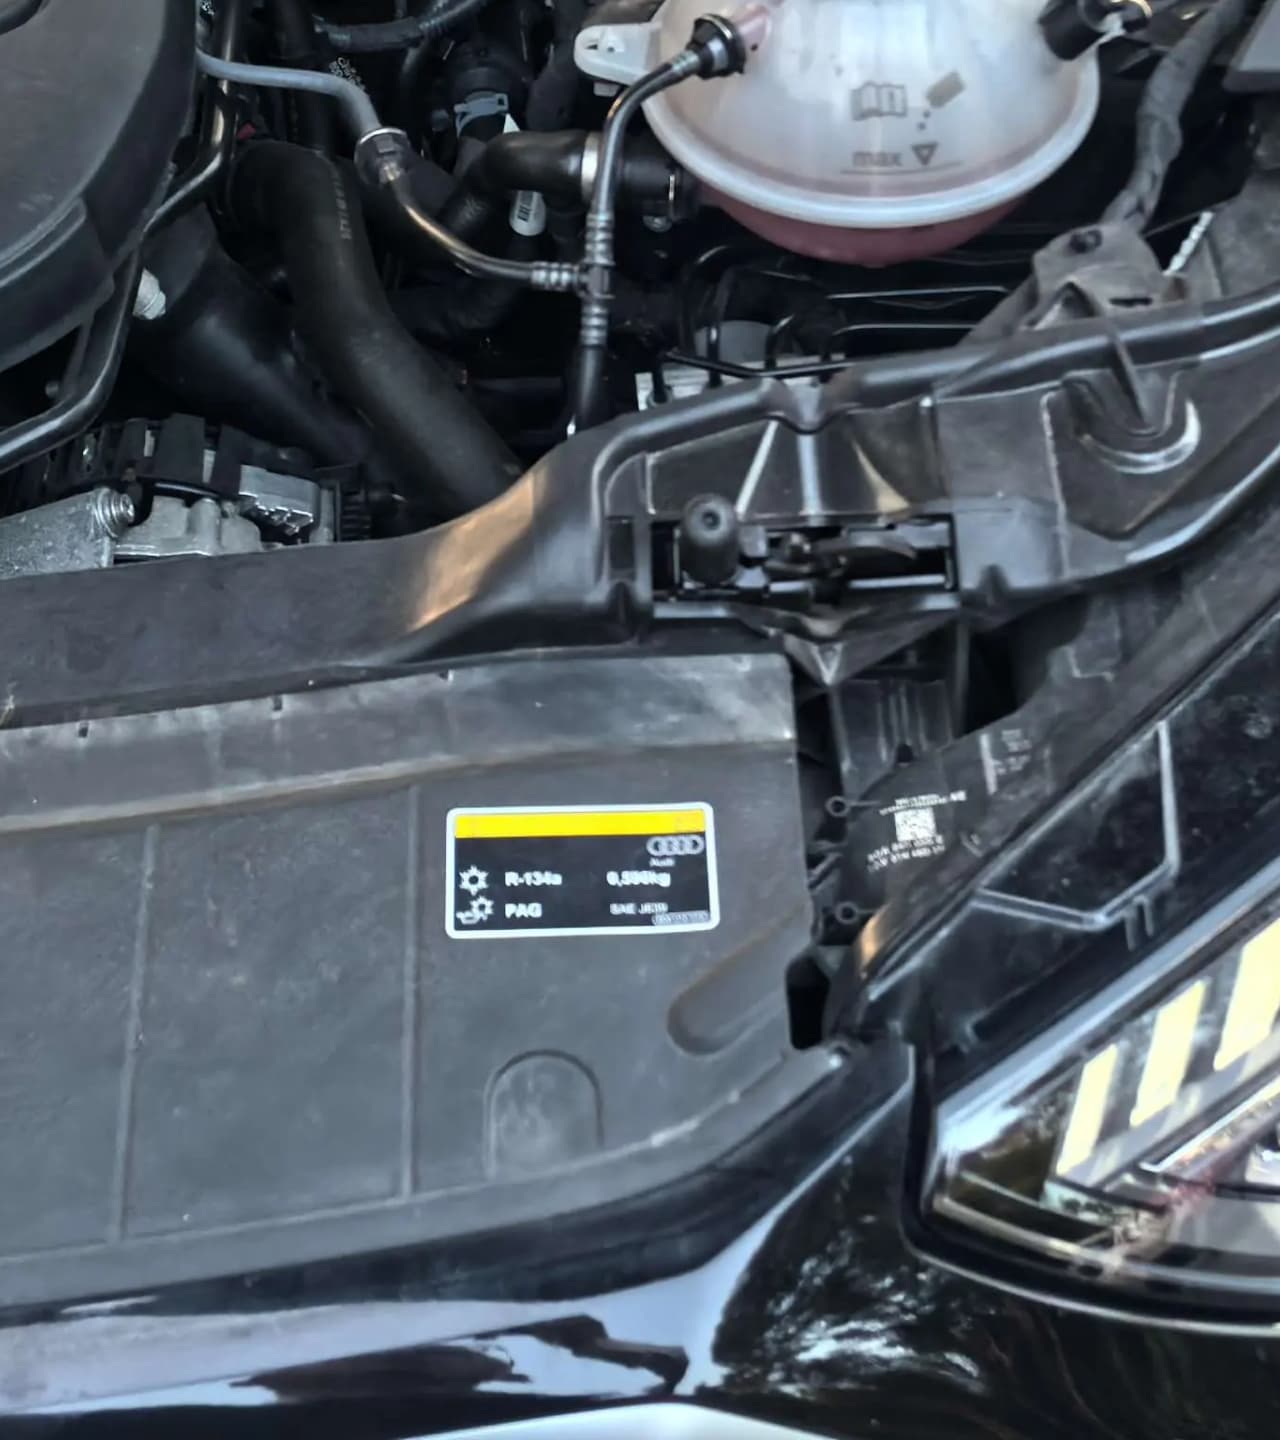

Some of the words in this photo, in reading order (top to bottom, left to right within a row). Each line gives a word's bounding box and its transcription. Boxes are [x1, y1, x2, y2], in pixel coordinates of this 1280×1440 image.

[852, 151, 902, 167] max
[504, 871, 563, 887] R-134a
[504, 902, 543, 918] PAG
